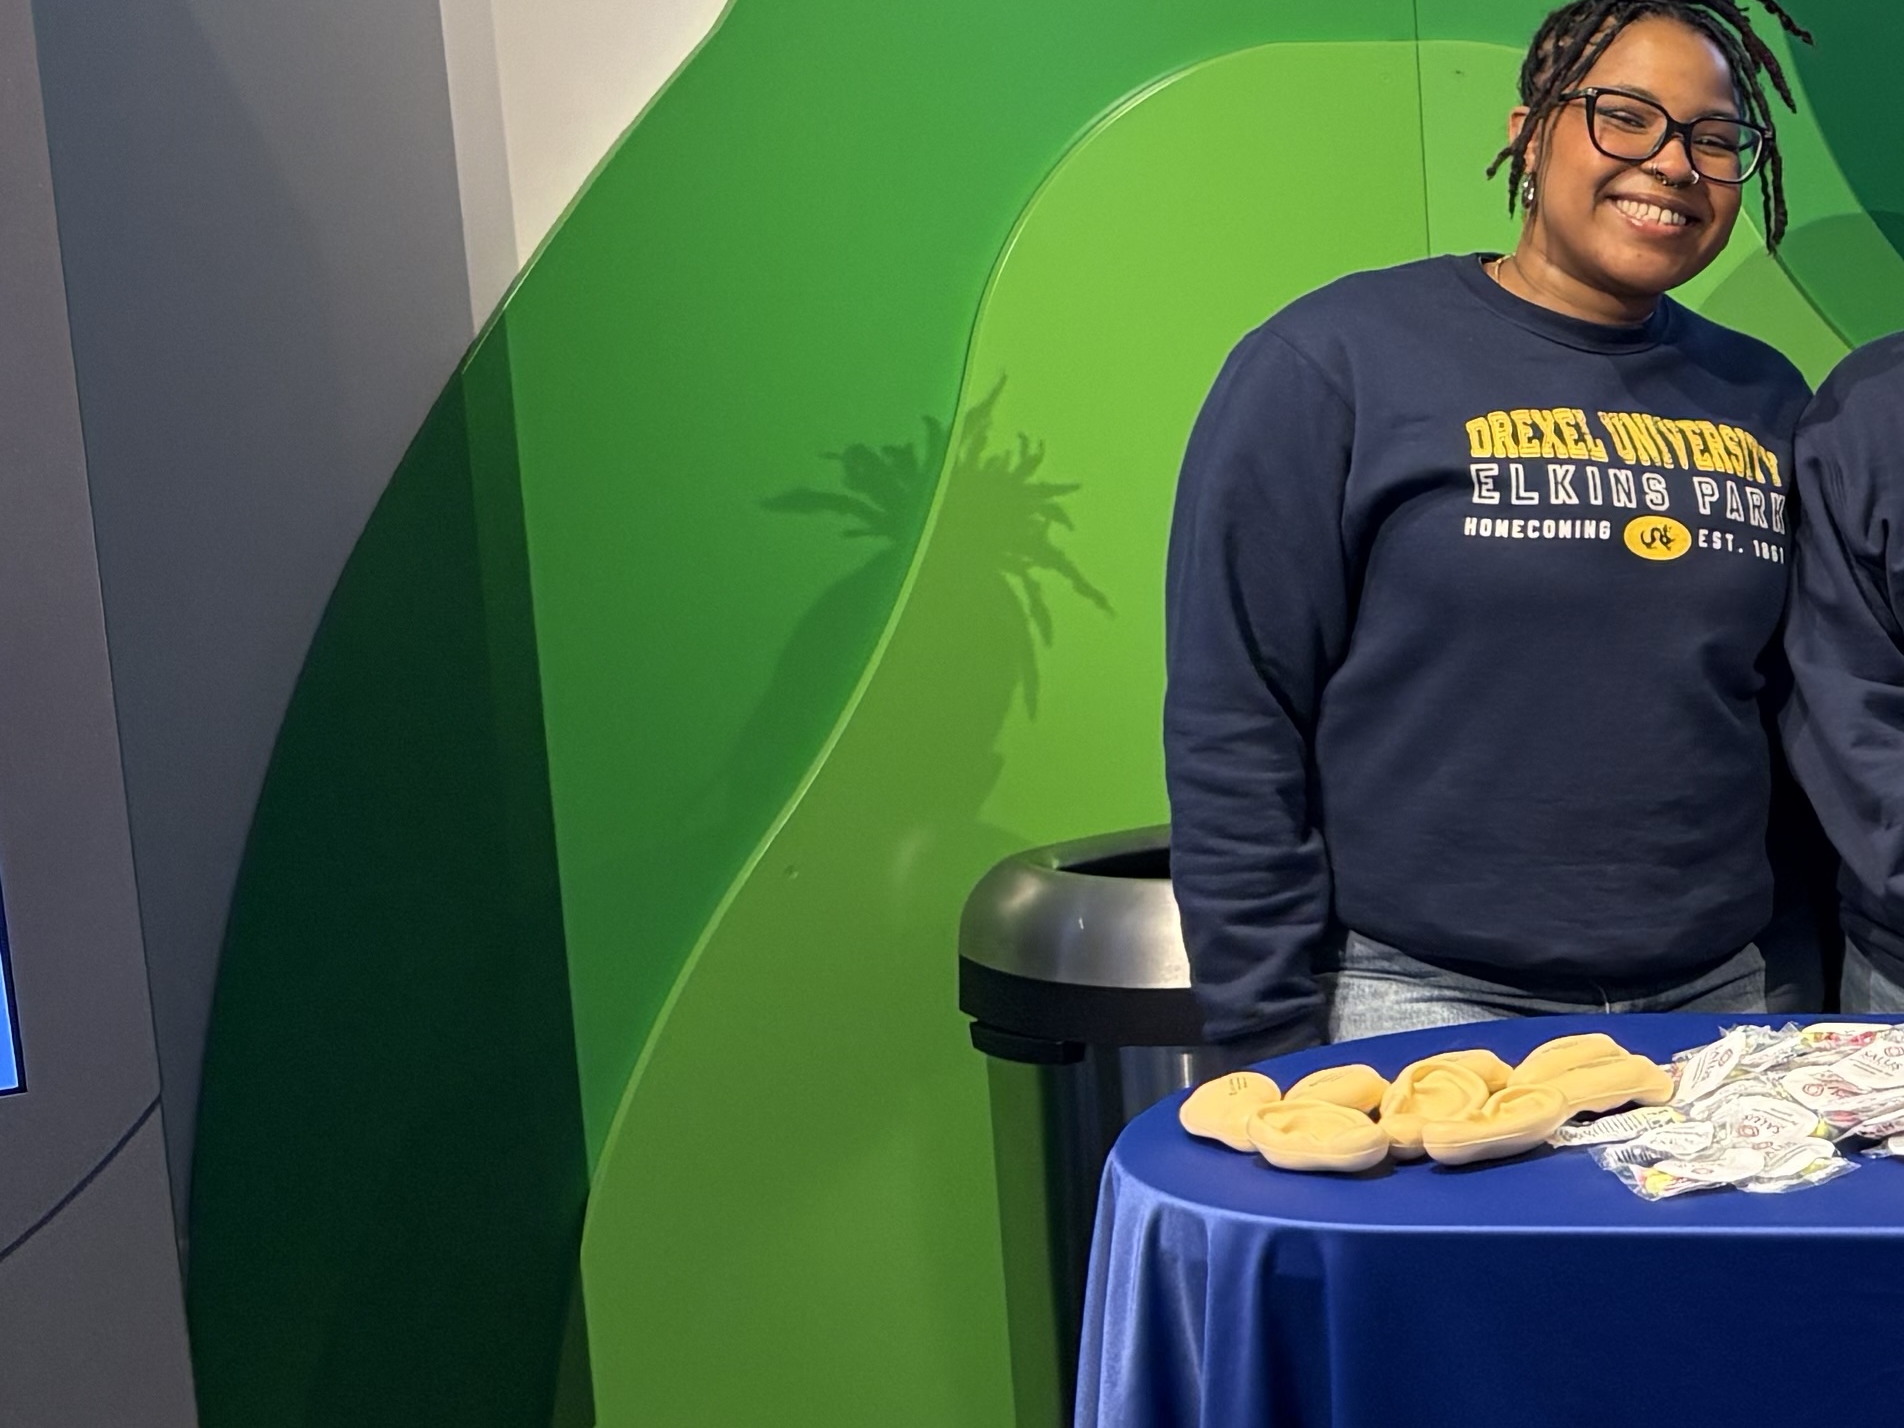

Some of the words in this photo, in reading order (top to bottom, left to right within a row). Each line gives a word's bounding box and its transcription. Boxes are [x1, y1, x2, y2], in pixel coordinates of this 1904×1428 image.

[1466, 408, 1608, 461] DREXEL
[1598, 411, 1782, 486] UNIVERSITY
[1470, 464, 1669, 511] ELKINS
[1693, 476, 1786, 534] PARK
[1464, 518, 1611, 540] HOMECOMING
[1698, 530, 1744, 553] EST.
